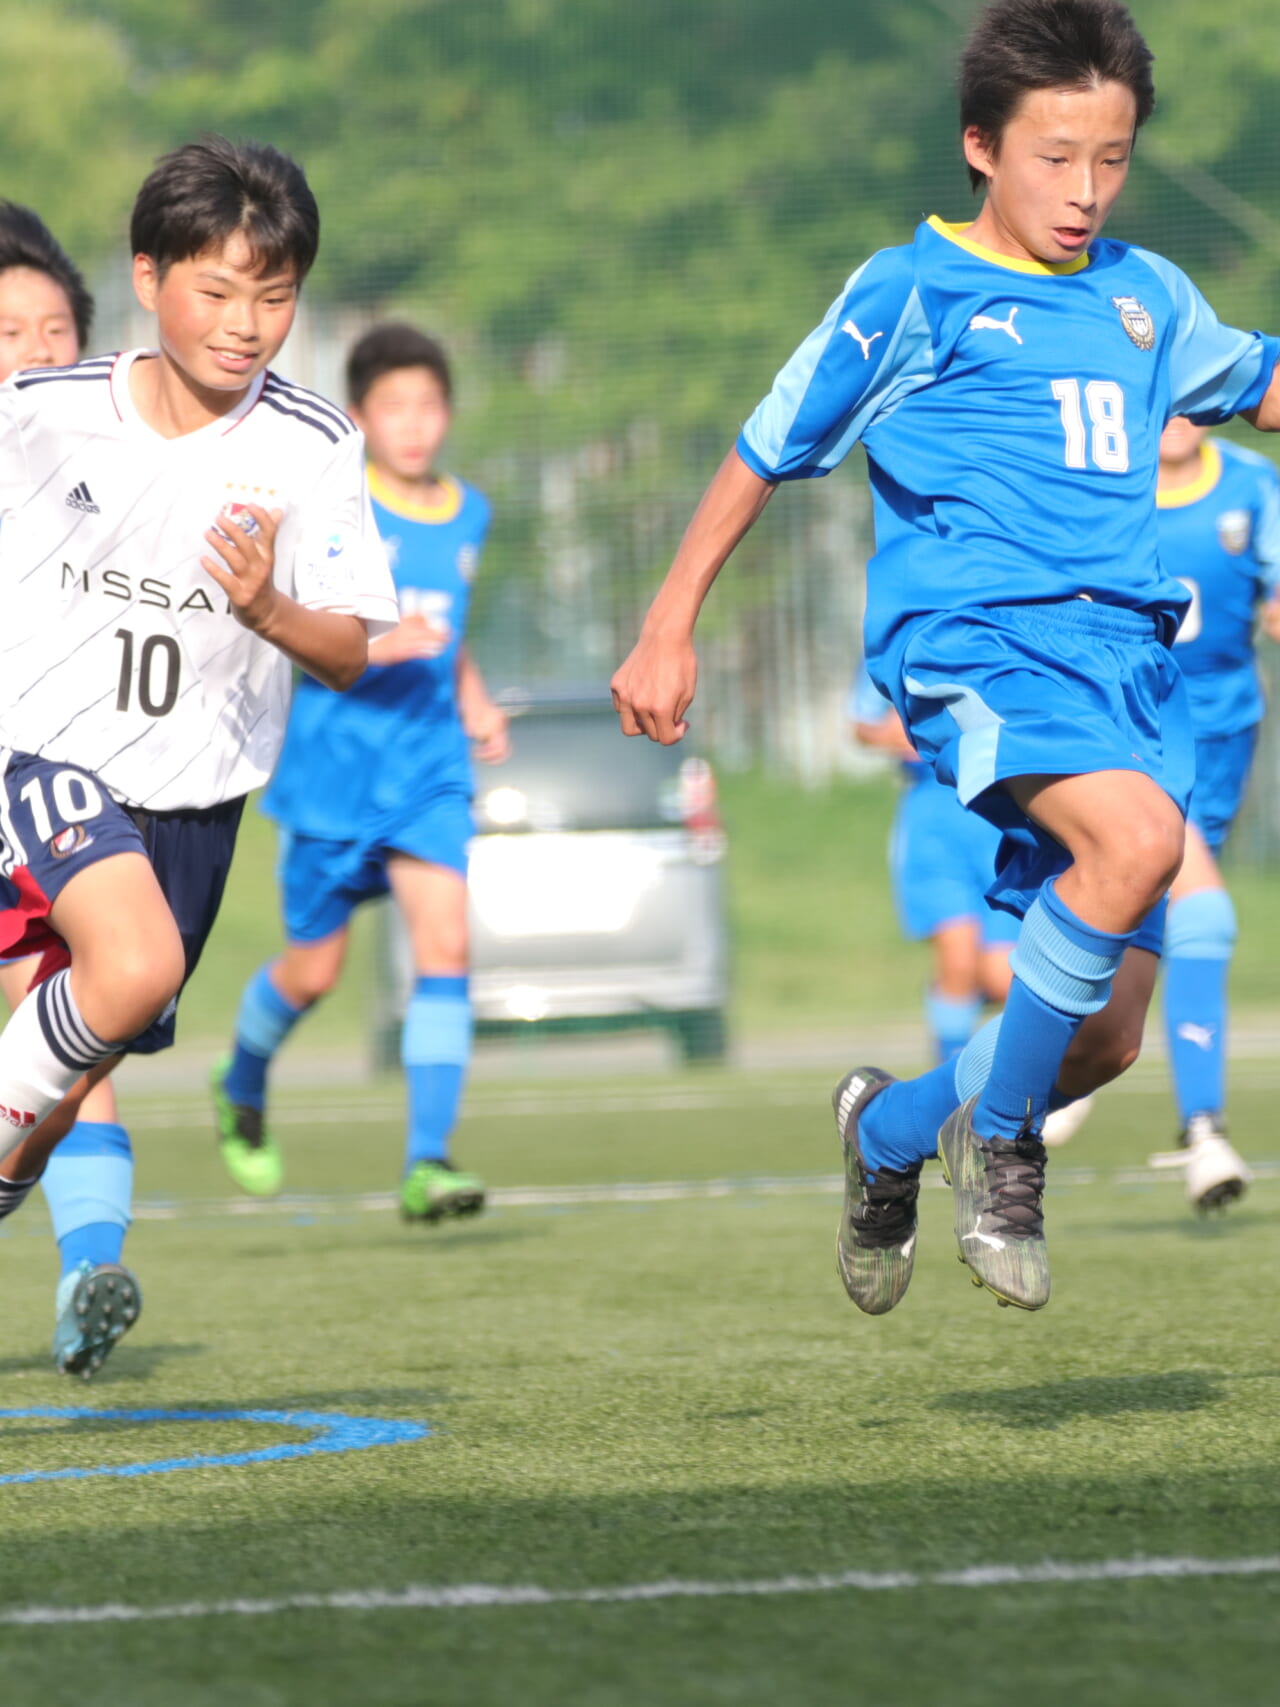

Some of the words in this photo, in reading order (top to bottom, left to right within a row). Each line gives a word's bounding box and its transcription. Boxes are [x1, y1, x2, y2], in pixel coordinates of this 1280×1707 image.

[1051, 378, 1129, 472] 18
[114, 627, 181, 718] 10
[20, 769, 103, 844] 10
